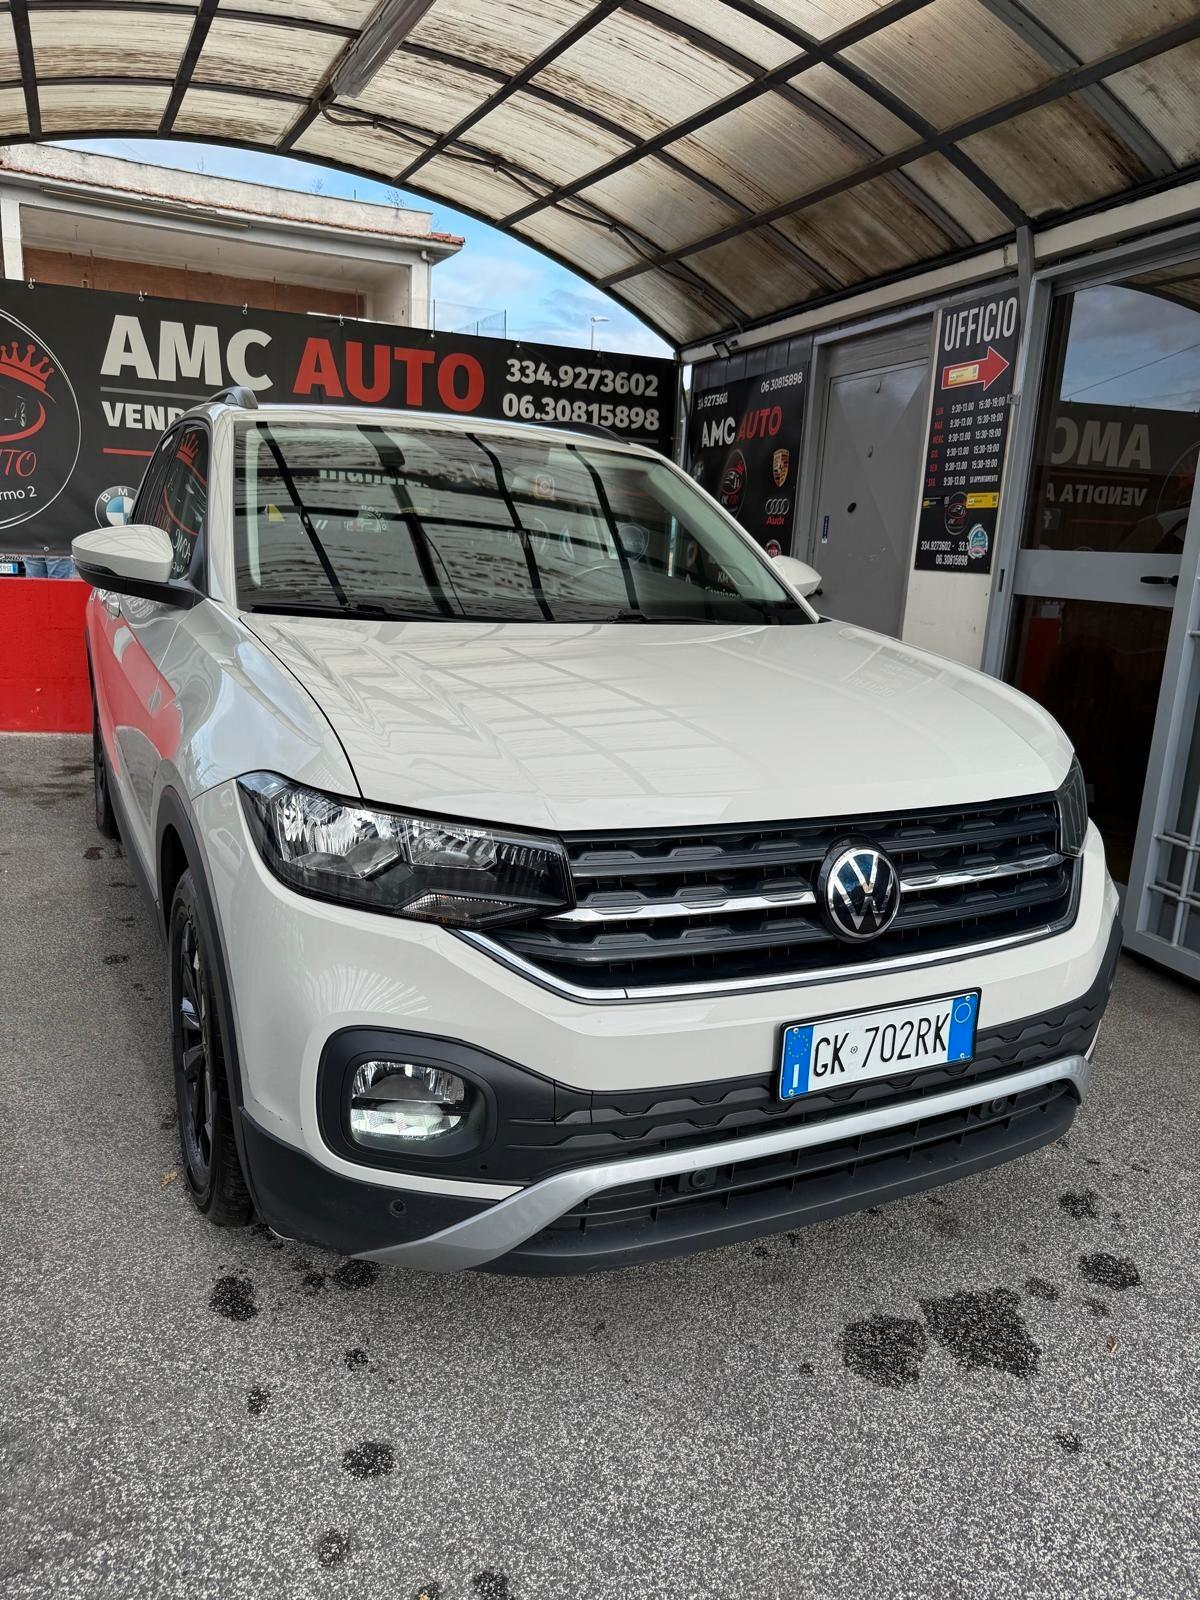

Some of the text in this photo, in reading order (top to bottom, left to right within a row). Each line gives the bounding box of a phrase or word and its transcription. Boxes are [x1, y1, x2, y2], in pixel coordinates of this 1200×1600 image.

[943, 297, 1018, 352] UFFICIO
[100, 314, 485, 412] AMC AUTO
[505, 358, 659, 397] 334.9273602
[502, 393, 660, 431] 06.30815898
[701, 405, 783, 448] AMC AUTO
[0, 448, 37, 477] TO
[27, 486, 37, 498] 2
[766, 516, 785, 526] Audi
[813, 1032, 850, 1078] GK
[862, 1012, 950, 1068] 702RK
